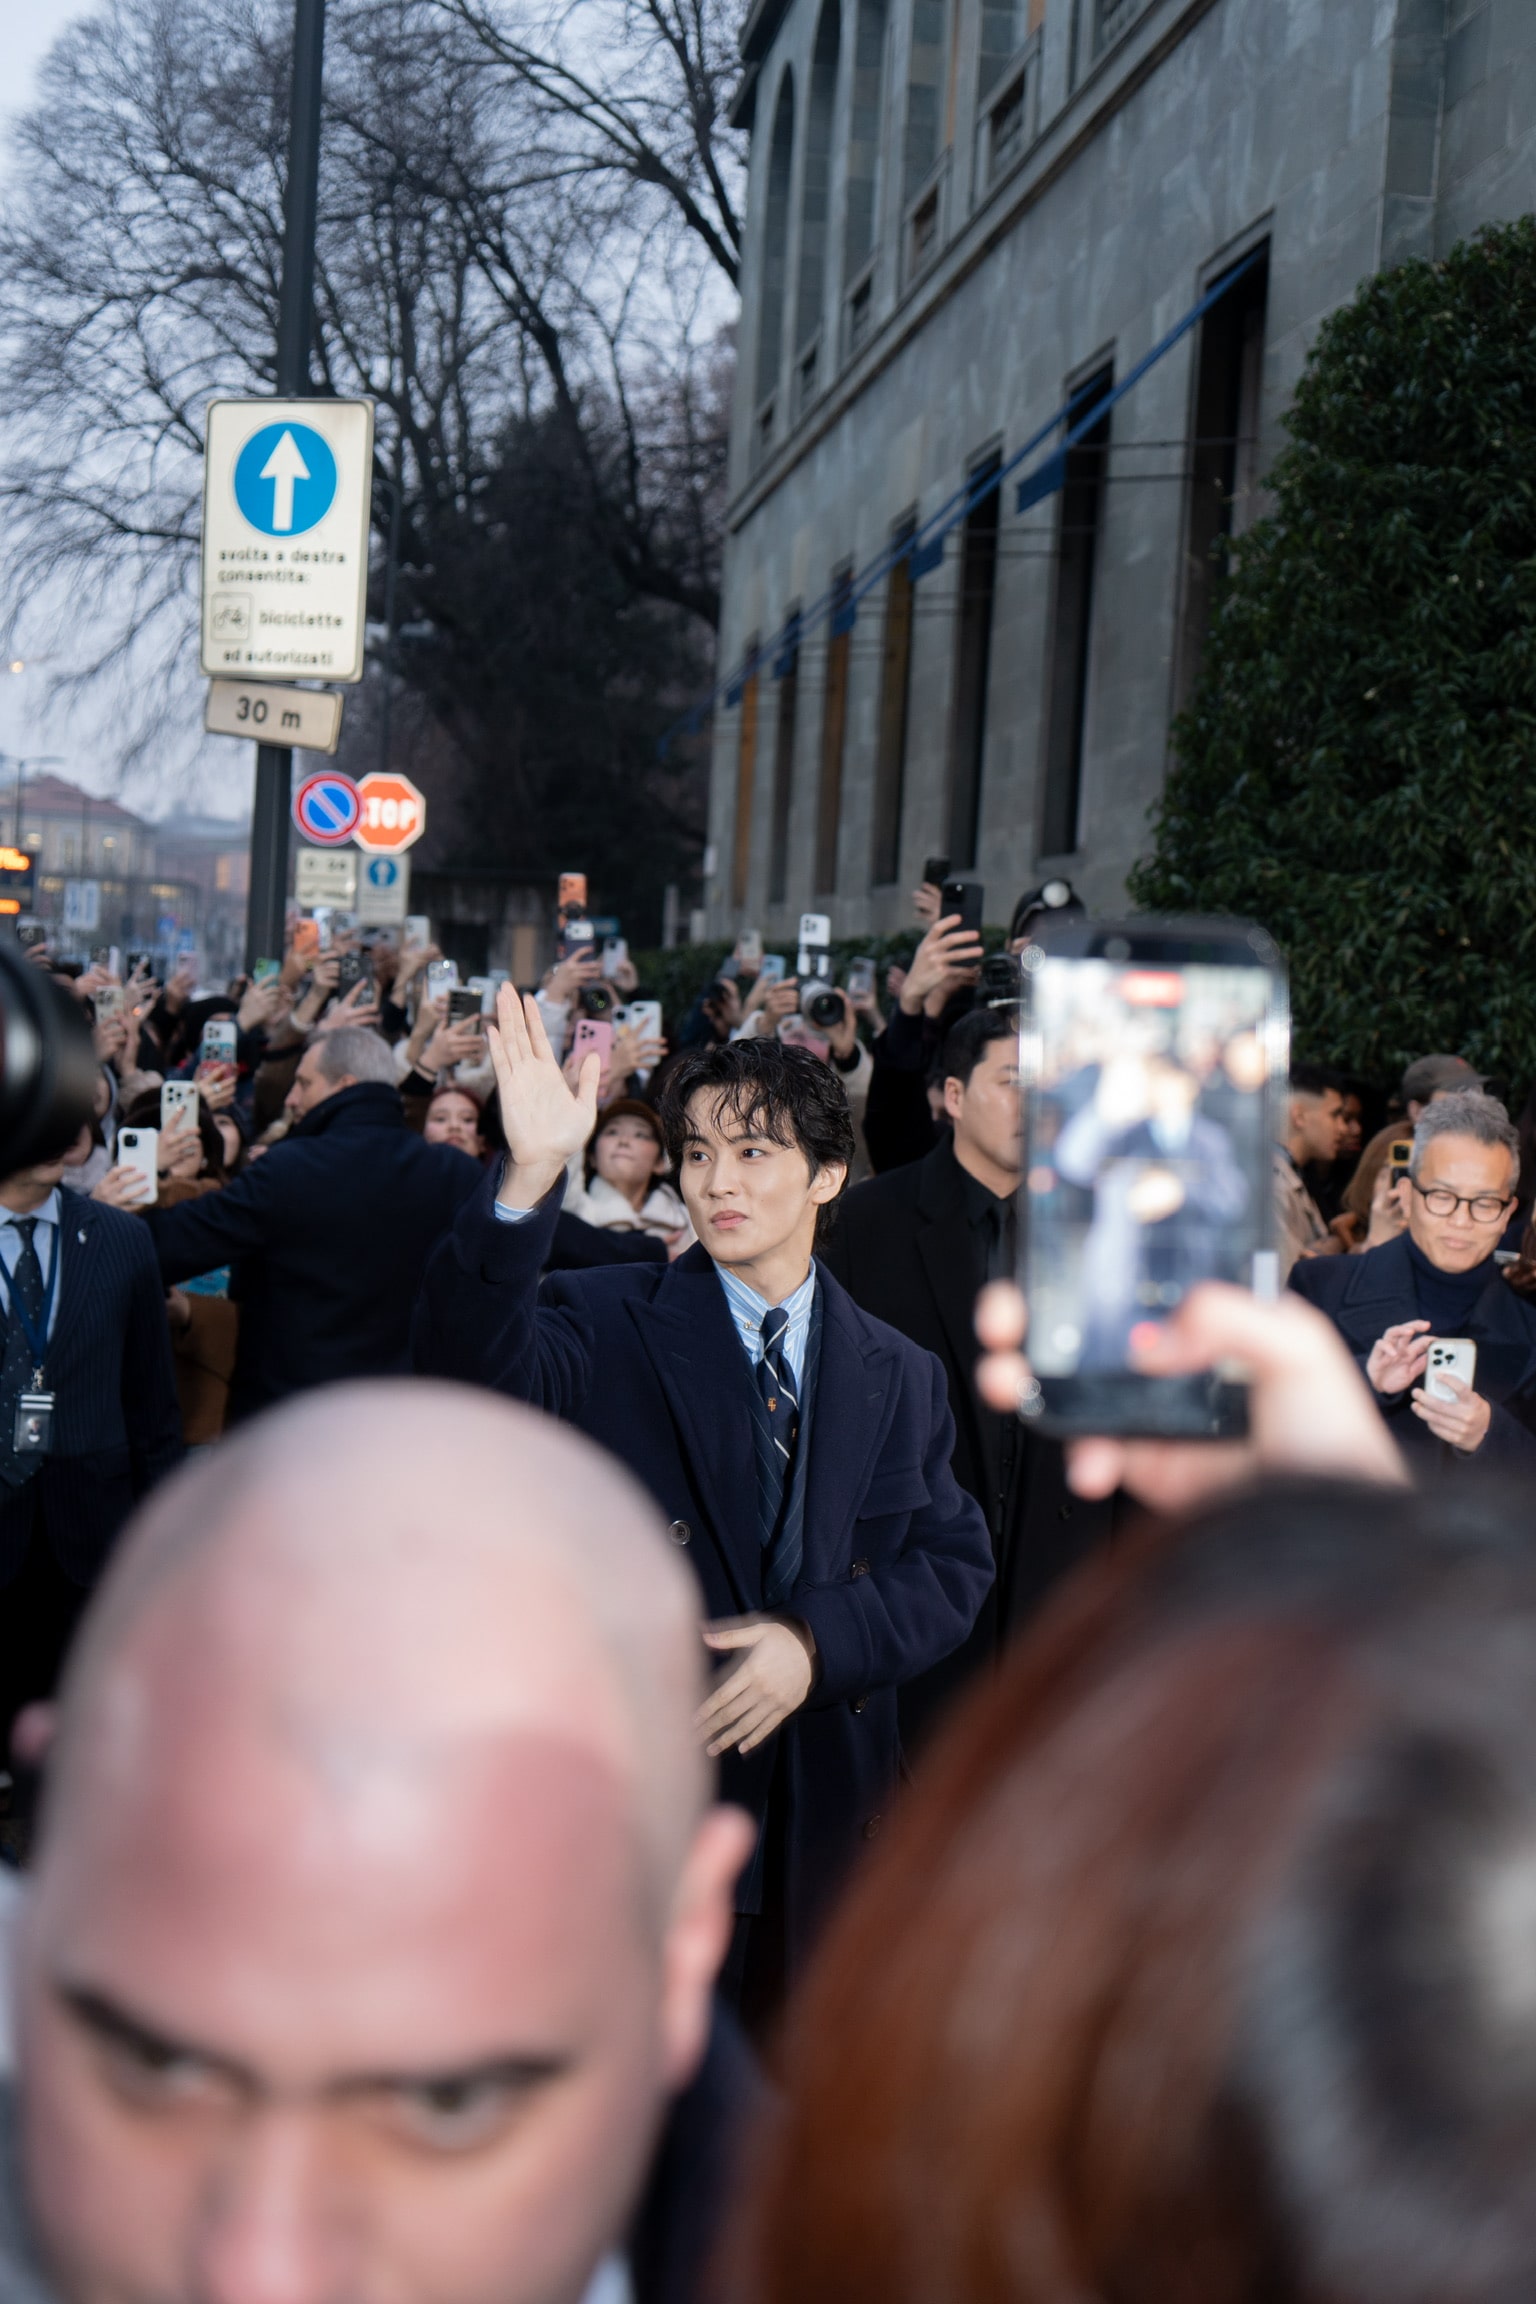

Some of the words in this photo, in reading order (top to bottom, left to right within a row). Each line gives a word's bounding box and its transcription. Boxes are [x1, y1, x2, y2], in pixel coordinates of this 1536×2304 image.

[219, 547, 268, 561] svolta
[275, 551, 284, 561] a
[291, 548, 345, 563] destra
[259, 609, 343, 627] biciclette
[223, 649, 241, 662] ed
[245, 649, 334, 665] autorizzati
[237, 695, 268, 723] 30
[281, 709, 301, 729] m
